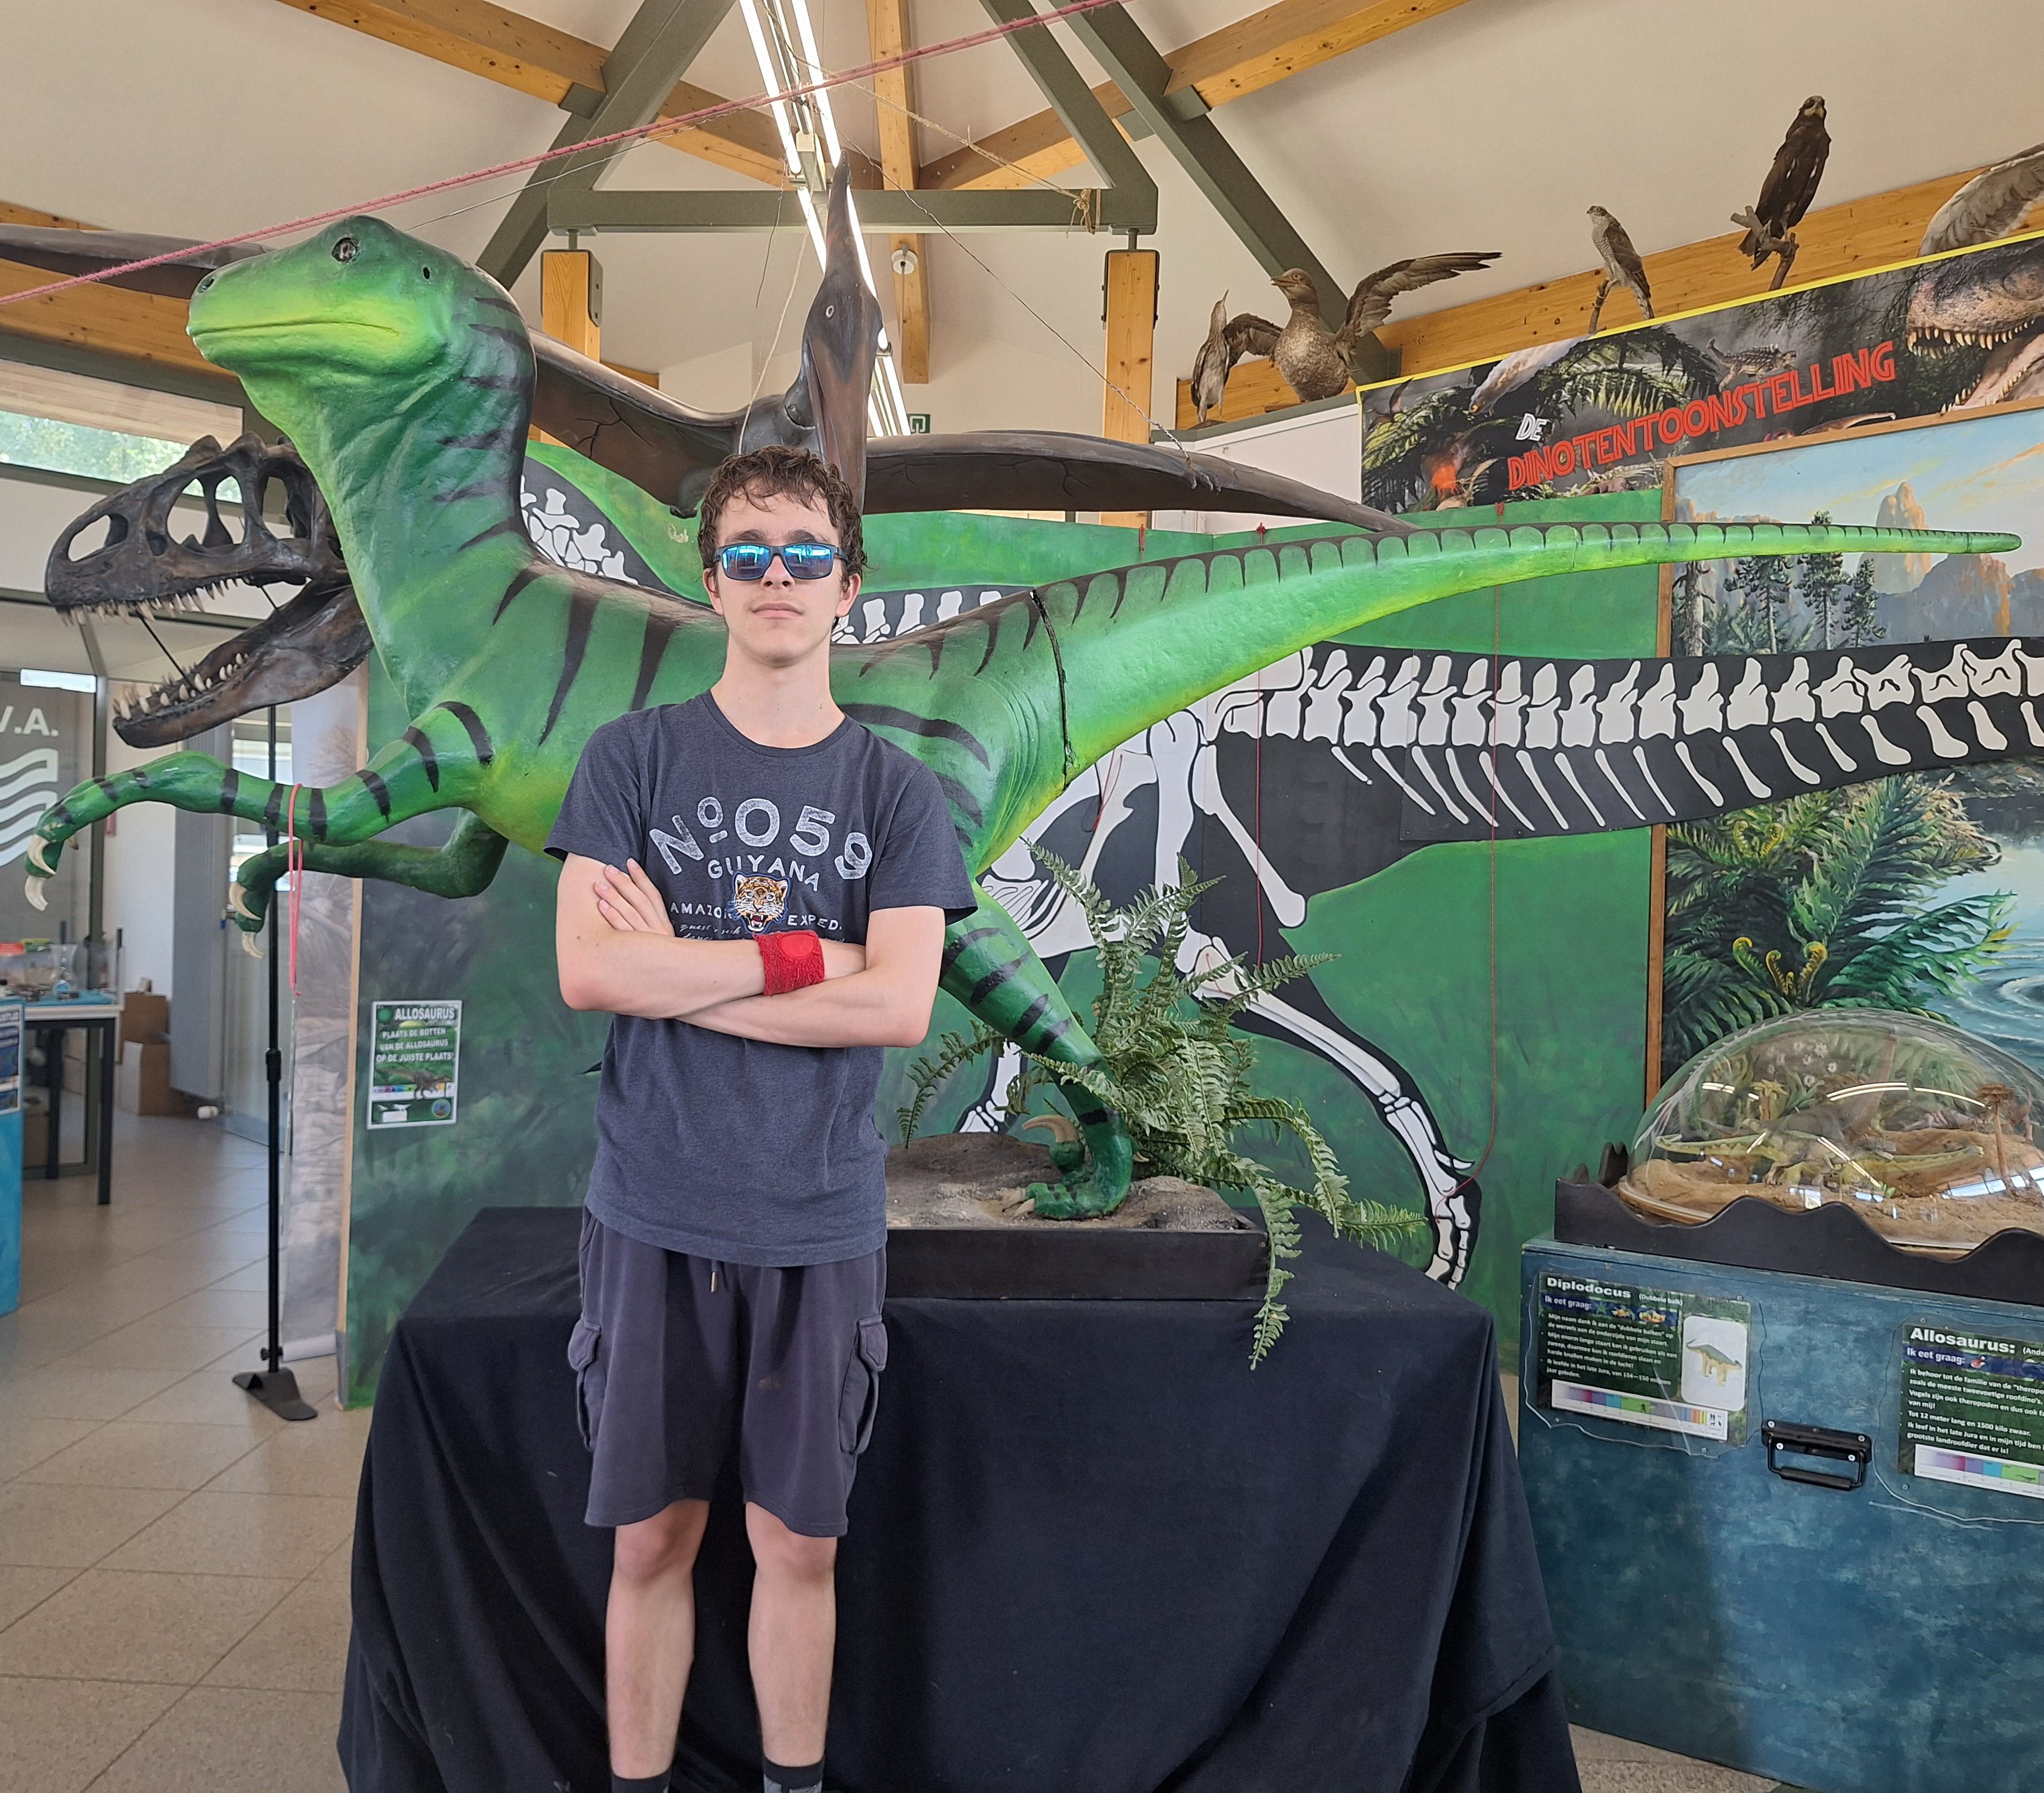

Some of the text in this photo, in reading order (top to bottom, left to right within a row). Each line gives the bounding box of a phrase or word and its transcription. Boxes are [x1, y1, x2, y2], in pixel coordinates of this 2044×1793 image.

[1507, 341, 1895, 490] DINOTENTOONSTELLING
[1514, 413, 1549, 441] DE
[708, 854, 819, 891] GUYANA
[787, 914, 842, 930] EXPED.
[395, 1007, 455, 1021] ALLOSAURUS
[383, 1027, 446, 1039] PLAATS DE BOTTEN
[380, 1039, 449, 1051] VAN DE ALLOSAURUS
[376, 1054, 387, 1062] OP
[388, 1054, 397, 1062] DE
[400, 1052, 424, 1062] JUISTE
[1547, 1277, 1683, 1306] Diplodocus (Dubbele balk)
[1554, 1298, 1566, 1306] eet
[1568, 1300, 1592, 1311] graag:
[1910, 1327, 2016, 1354] Allosaurus:
[1907, 1348, 1965, 1365] Ik eet graag:
[1917, 1369, 1941, 1378] behoor
[1964, 1376, 1987, 1385] familie
[1909, 1389, 1930, 1398] Vogels
[1958, 1397, 1999, 1409] theropoden
[1963, 1386, 2005, 1399] tweevoetige
[1908, 1410, 1919, 1418] Tot
[1930, 1414, 1950, 1423] meter
[1951, 1417, 1965, 1426] lang
[1977, 1422, 1994, 1430] 1500
[2009, 1428, 2031, 1436] zwaar.
[1907, 1432, 1935, 1441] grootste
[1936, 1436, 1978, 1448] landroofdier
[1964, 1431, 1978, 1439] Jura
[2028, 1441, 2041, 1450] ben
